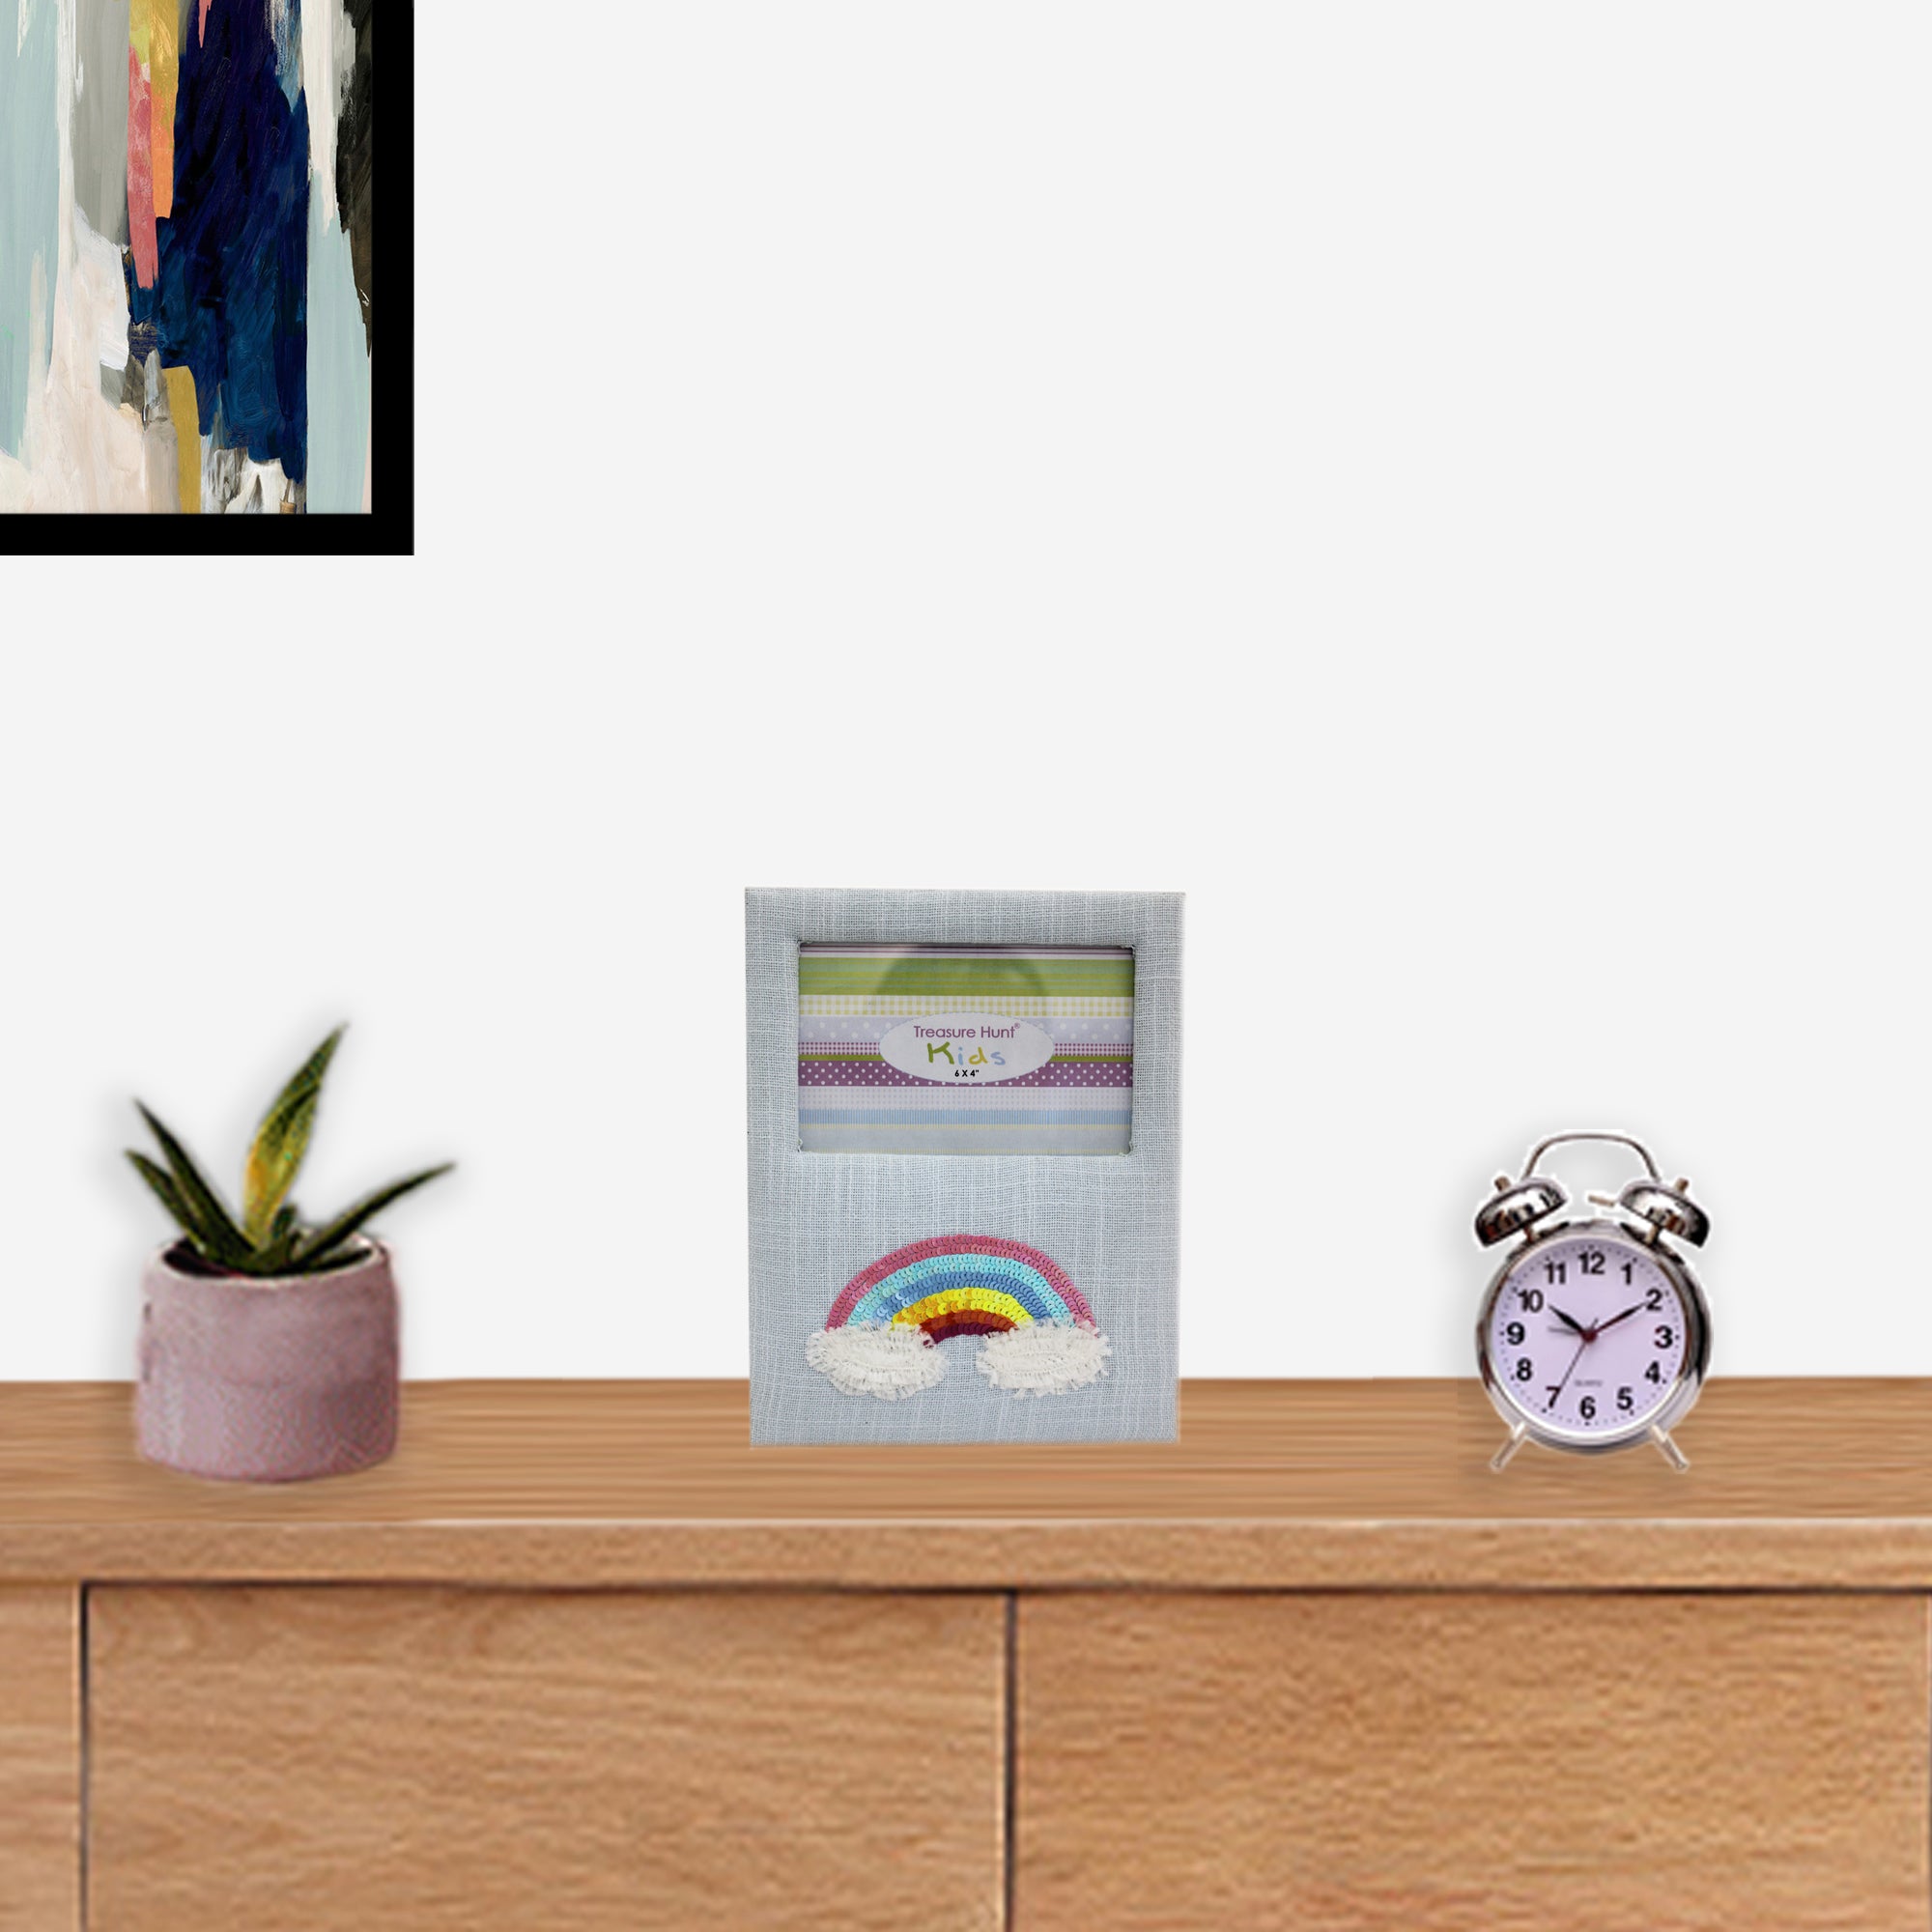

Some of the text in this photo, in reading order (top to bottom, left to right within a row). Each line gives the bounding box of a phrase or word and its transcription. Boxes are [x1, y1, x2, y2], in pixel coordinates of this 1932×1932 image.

[914, 1026, 976, 1038] Treasure
[927, 1041, 1006, 1065] Kids
[1545, 1263, 1566, 1285] 11
[1577, 1252, 1605, 1275] 12
[1621, 1263, 1632, 1286] 1
[1518, 1289, 1544, 1313] 10
[1645, 1289, 1663, 1311] 2
[1506, 1321, 1525, 1346] 9
[1654, 1325, 1673, 1349] 3
[1517, 1358, 1532, 1381] 8
[1645, 1361, 1661, 1384] 4
[1546, 1386, 1561, 1408] 7
[1580, 1397, 1596, 1419] 6
[1617, 1387, 1634, 1410] 5
